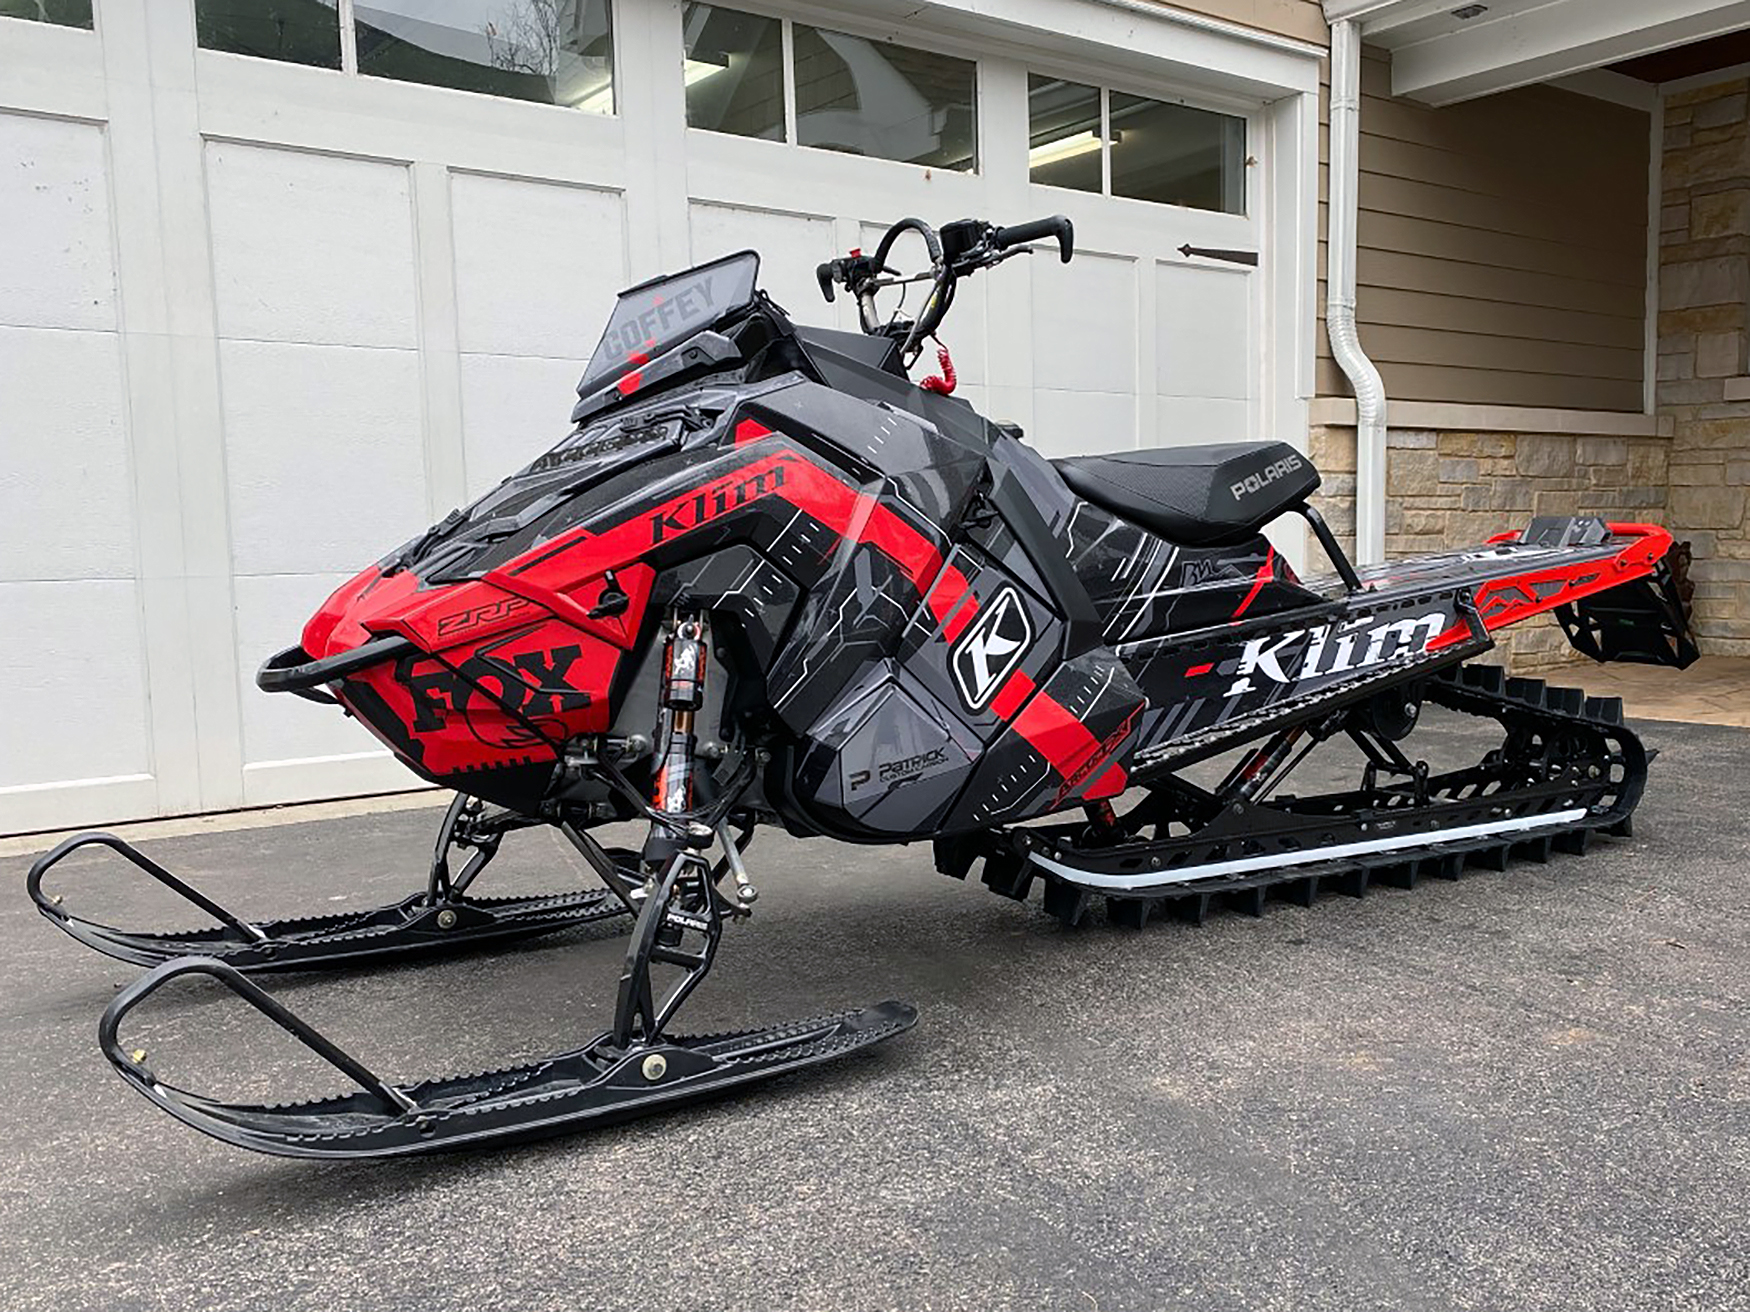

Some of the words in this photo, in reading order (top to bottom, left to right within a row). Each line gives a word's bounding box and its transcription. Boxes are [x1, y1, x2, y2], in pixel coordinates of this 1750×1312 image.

[603, 276, 716, 360] COFFEY
[650, 466, 785, 545] Klim
[1230, 454, 1303, 500] POLARIS
[438, 597, 530, 635] ZRP
[1223, 612, 1447, 698] Klim
[408, 644, 592, 733] FOX
